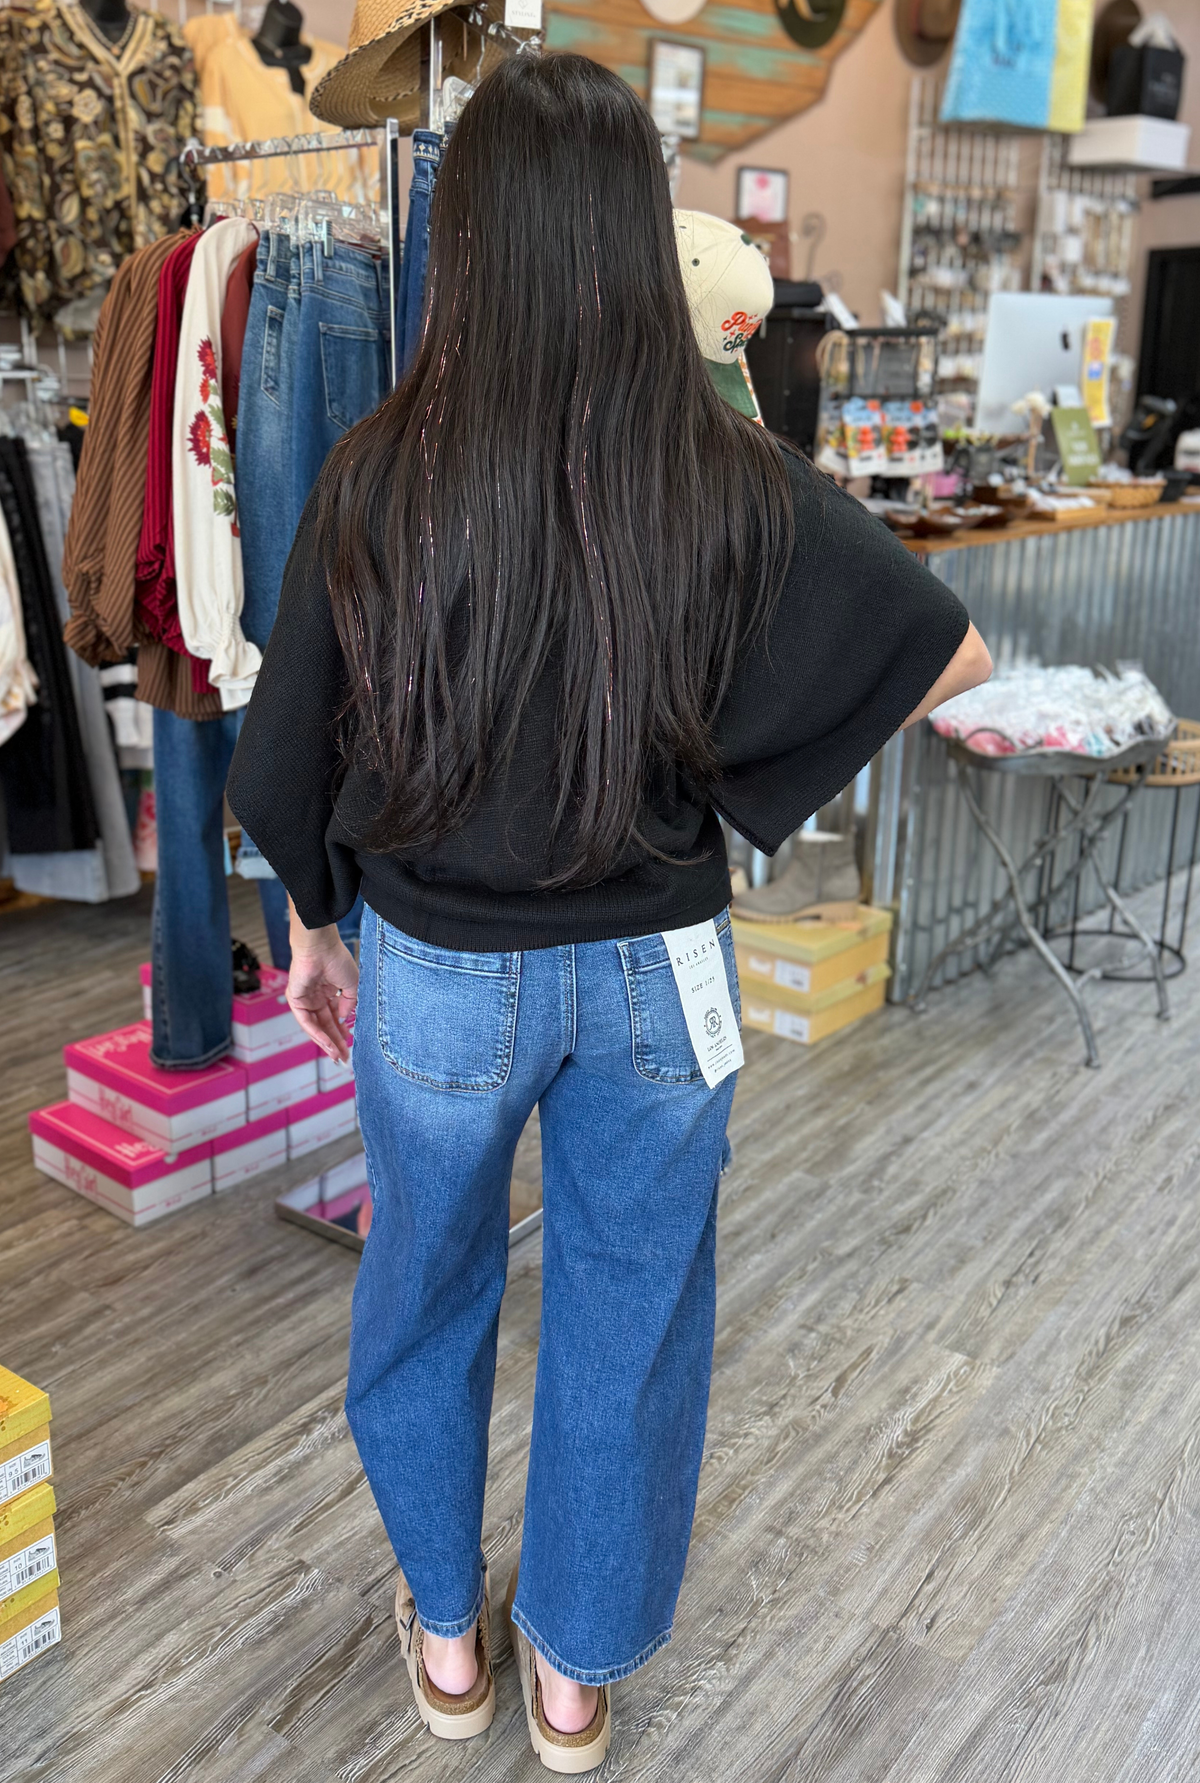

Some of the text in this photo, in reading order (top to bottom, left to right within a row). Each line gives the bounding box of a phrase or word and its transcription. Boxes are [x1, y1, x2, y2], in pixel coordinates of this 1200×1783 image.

[676, 939, 716, 966] RISEN
[691, 982, 703, 993] SIZE
[15, 1563, 22, 1571] 10
